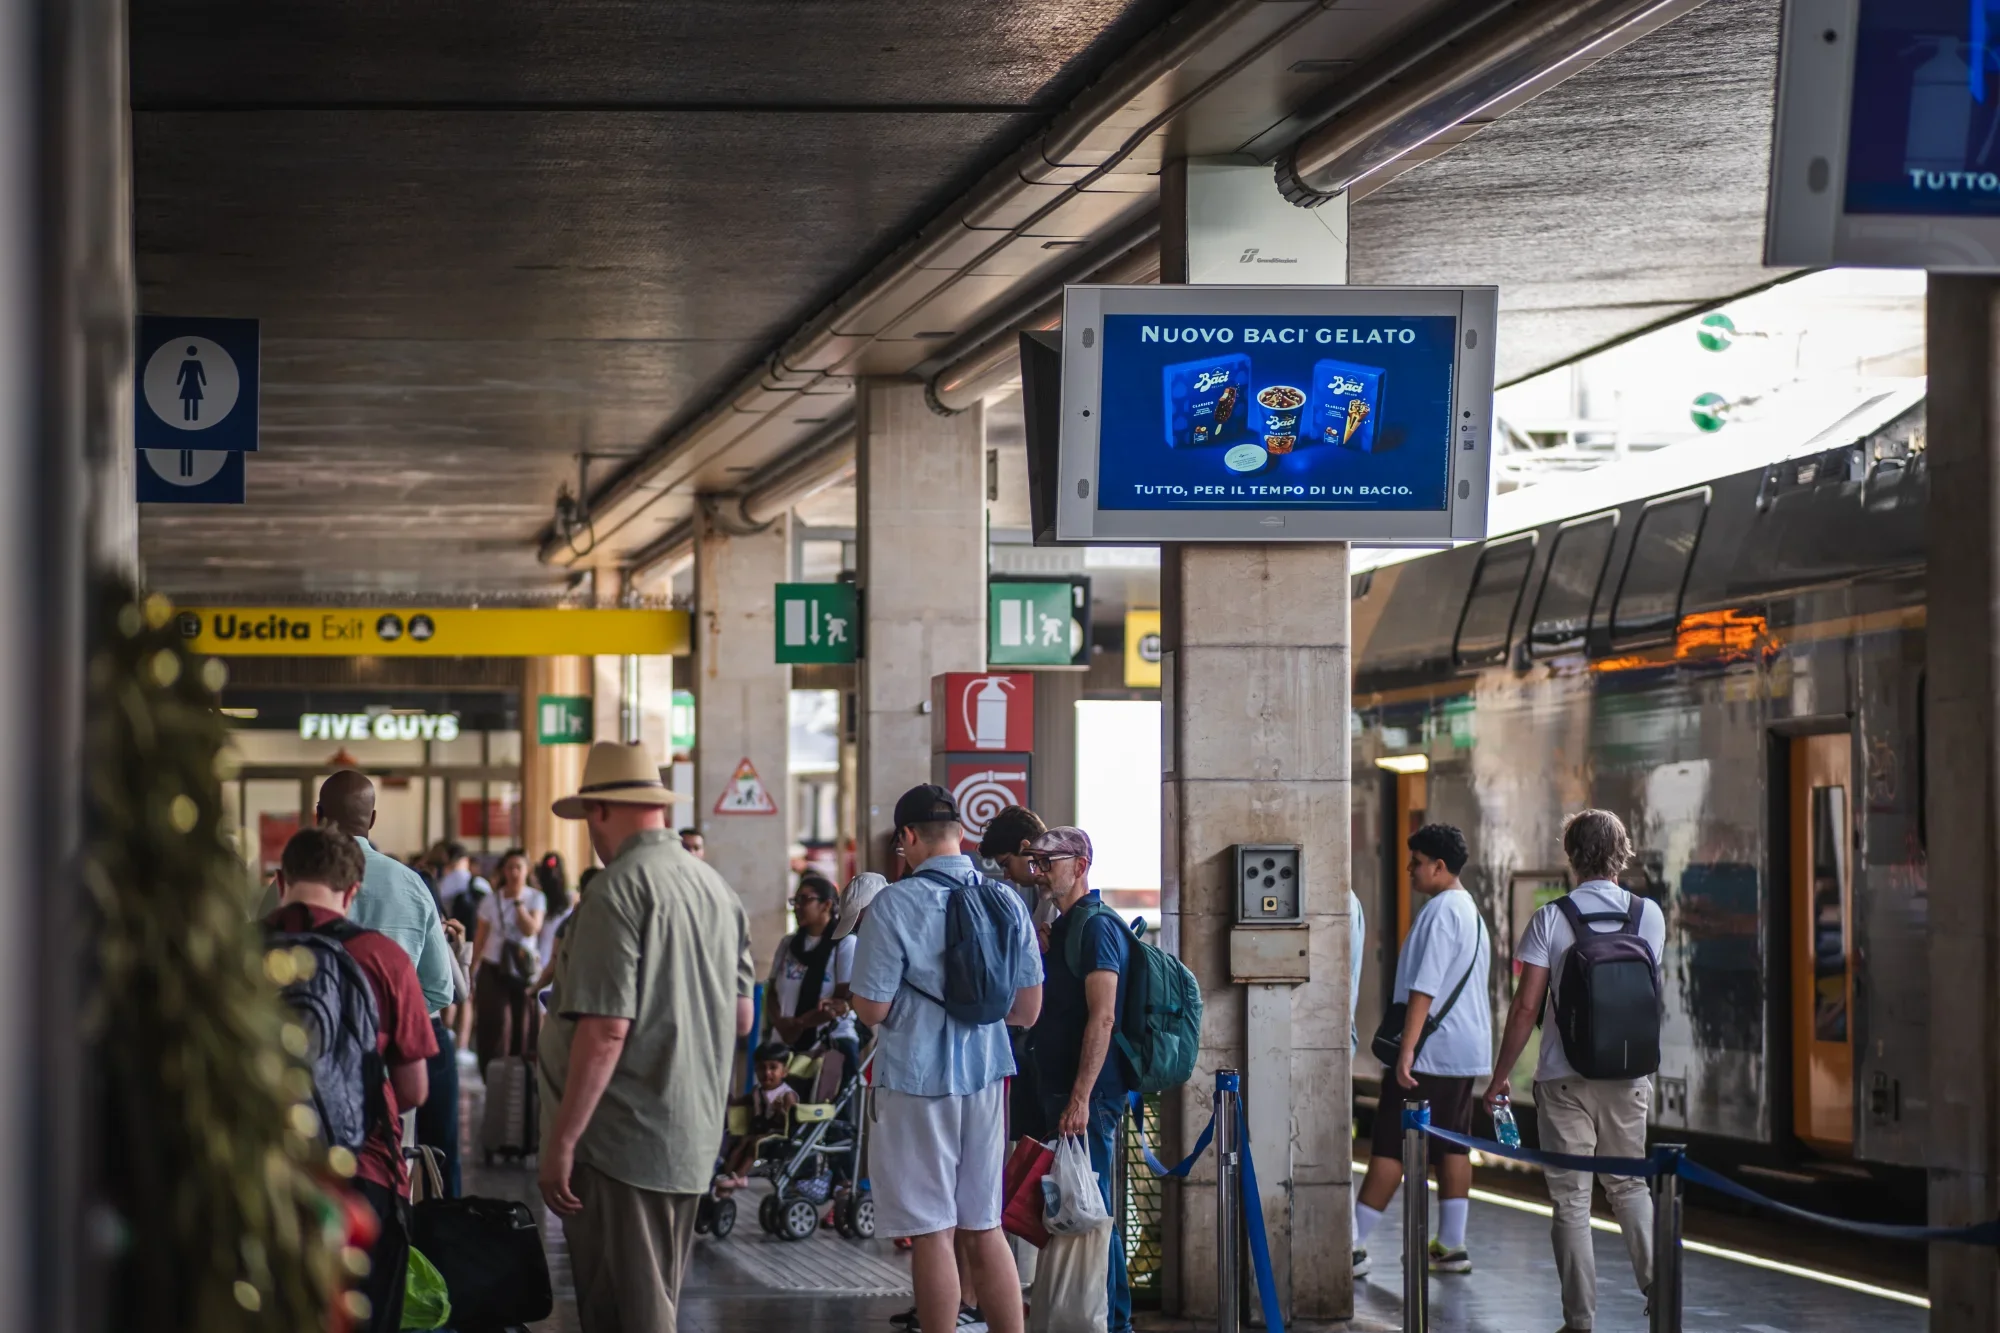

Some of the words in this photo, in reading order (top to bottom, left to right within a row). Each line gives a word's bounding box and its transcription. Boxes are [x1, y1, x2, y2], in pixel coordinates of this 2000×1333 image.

[1909, 168, 2000, 191] TUTTO
[1141, 325, 1235, 343] NUOVO
[1315, 328, 1416, 344] GELATO
[1193, 370, 1230, 392] Baci
[1327, 375, 1365, 395] Baci
[1265, 415, 1297, 430] Baci
[1134, 483, 1188, 497] TUTTO,
[1193, 484, 1225, 495] PER
[1230, 485, 1245, 495] IL
[1249, 485, 1305, 496] TEMPO
[1309, 485, 1326, 495] DI
[1331, 485, 1354, 496] UN
[1359, 485, 1413, 496] BACIO.
[213, 613, 311, 641] Uscita
[321, 614, 364, 640] Exit
[300, 713, 371, 741] FIVE
[374, 713, 460, 741] GUYS
